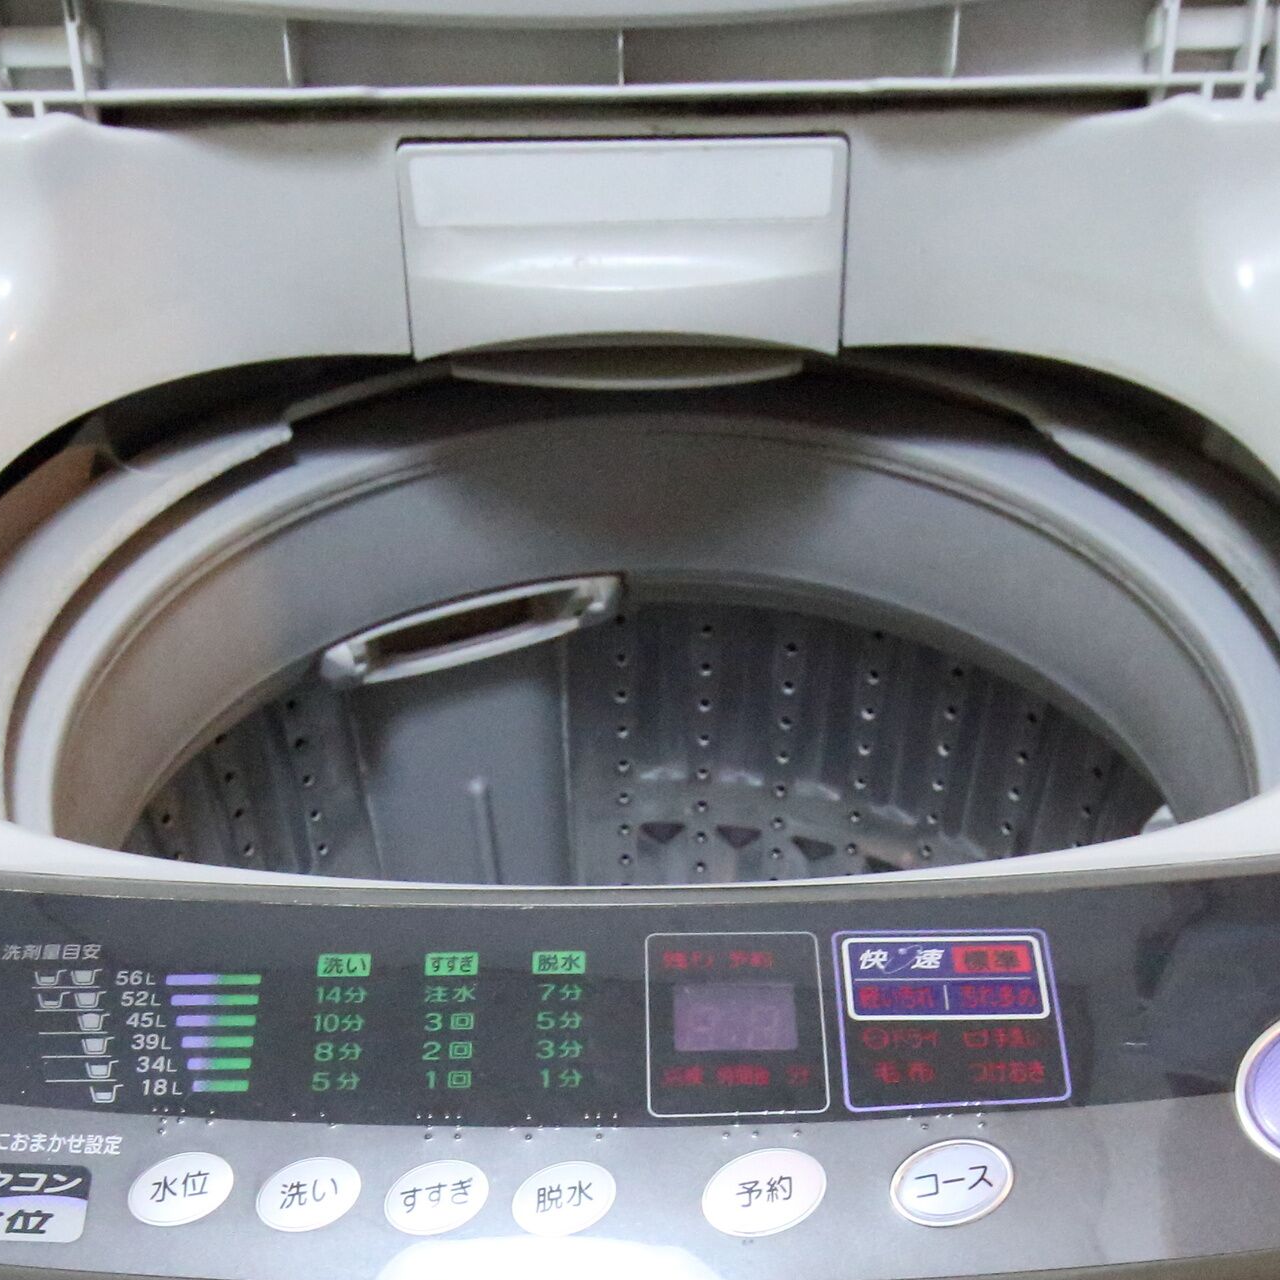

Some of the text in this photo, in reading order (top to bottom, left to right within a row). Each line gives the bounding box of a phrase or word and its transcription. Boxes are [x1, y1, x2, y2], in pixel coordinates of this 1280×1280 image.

[2, 943, 102, 961] 洗剤量目安
[322, 956, 367, 975] 洗い
[429, 955, 474, 973] すすぎ
[537, 953, 582, 973] 脱水
[315, 985, 368, 1003] 14分
[424, 984, 476, 1003] 注水
[537, 983, 583, 1002] 7分
[314, 1013, 366, 1033] 10分
[423, 1012, 475, 1032] 3回
[535, 1011, 584, 1030] 5分
[313, 1041, 363, 1061] 8分
[421, 1041, 473, 1061] 2回
[535, 1039, 584, 1060] 3分
[311, 1071, 361, 1092] 5分
[425, 1069, 472, 1089] 1回
[539, 1067, 584, 1089] 1分
[149, 1169, 211, 1203] 水位
[736, 1174, 793, 1209] 予約
[913, 1164, 994, 1199] コース
[279, 1177, 339, 1210] 洗い
[399, 1177, 474, 1214] すすぎ
[536, 1179, 595, 1214] 脱水
